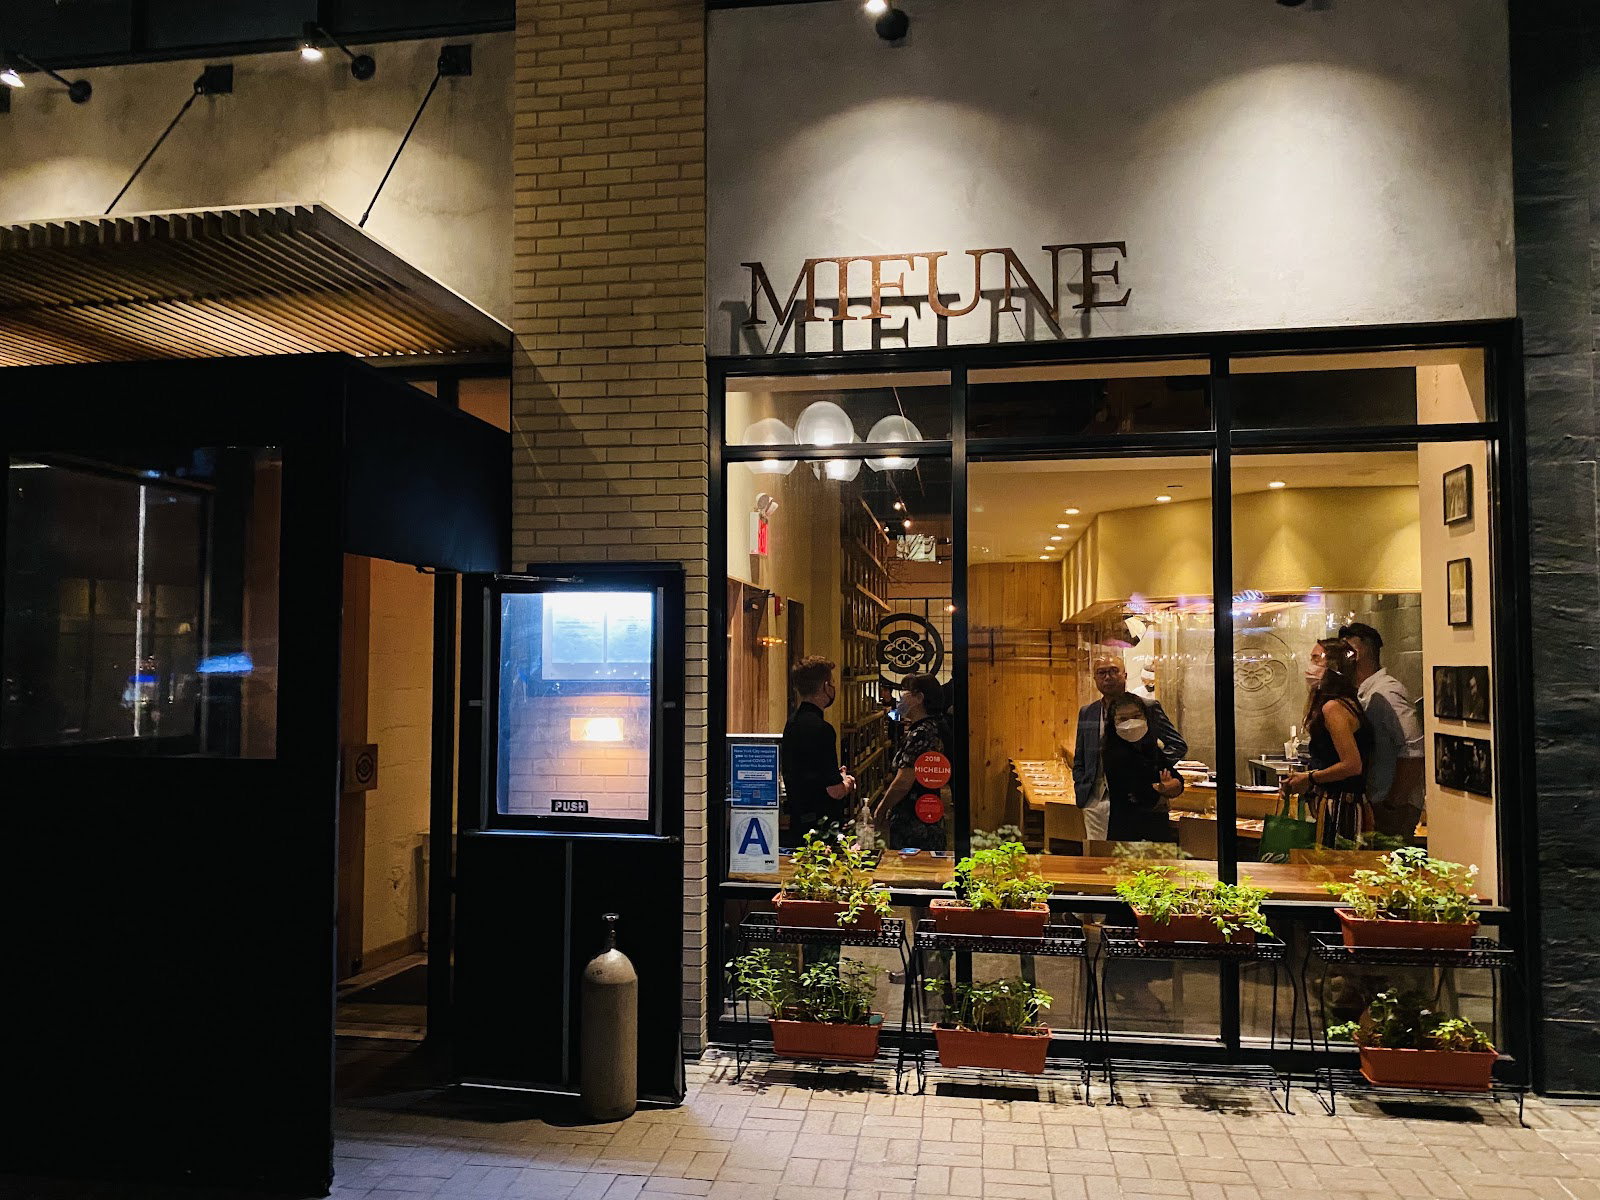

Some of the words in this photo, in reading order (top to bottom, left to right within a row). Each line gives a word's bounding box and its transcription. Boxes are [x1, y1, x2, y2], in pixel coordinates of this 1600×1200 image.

[740, 240, 1132, 326] MIFUNE
[914, 766, 951, 774] MICHELIN
[554, 801, 587, 812] PUSH
[738, 817, 771, 855] A
